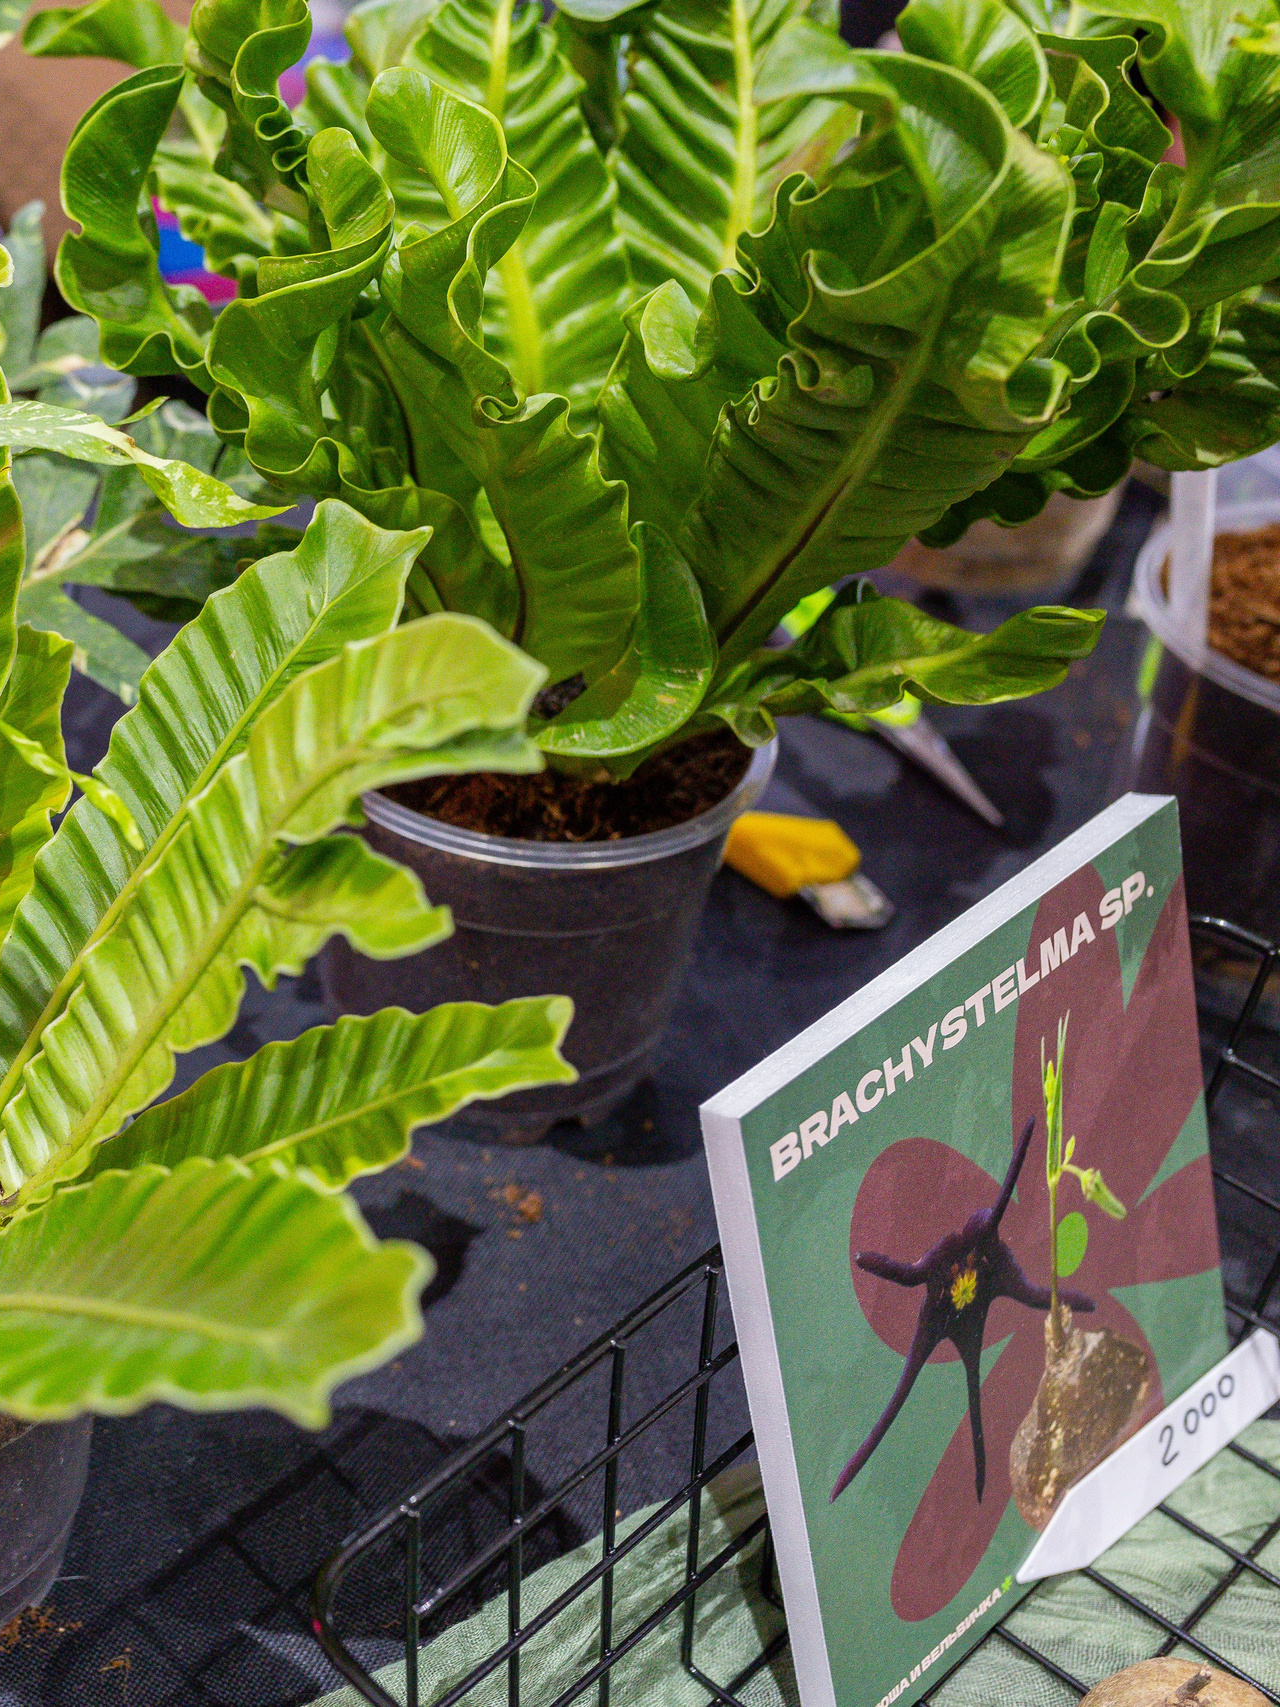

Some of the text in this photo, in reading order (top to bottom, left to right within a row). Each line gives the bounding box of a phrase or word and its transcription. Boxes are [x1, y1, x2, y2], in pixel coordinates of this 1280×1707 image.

[768, 871, 1154, 1182] BRACHYSTELMA SP.
[1159, 1374, 1235, 1466] 2000
[910, 1664, 922, 1683] И
[921, 1587, 1002, 1672] ВЕЛЬВИЧКА
